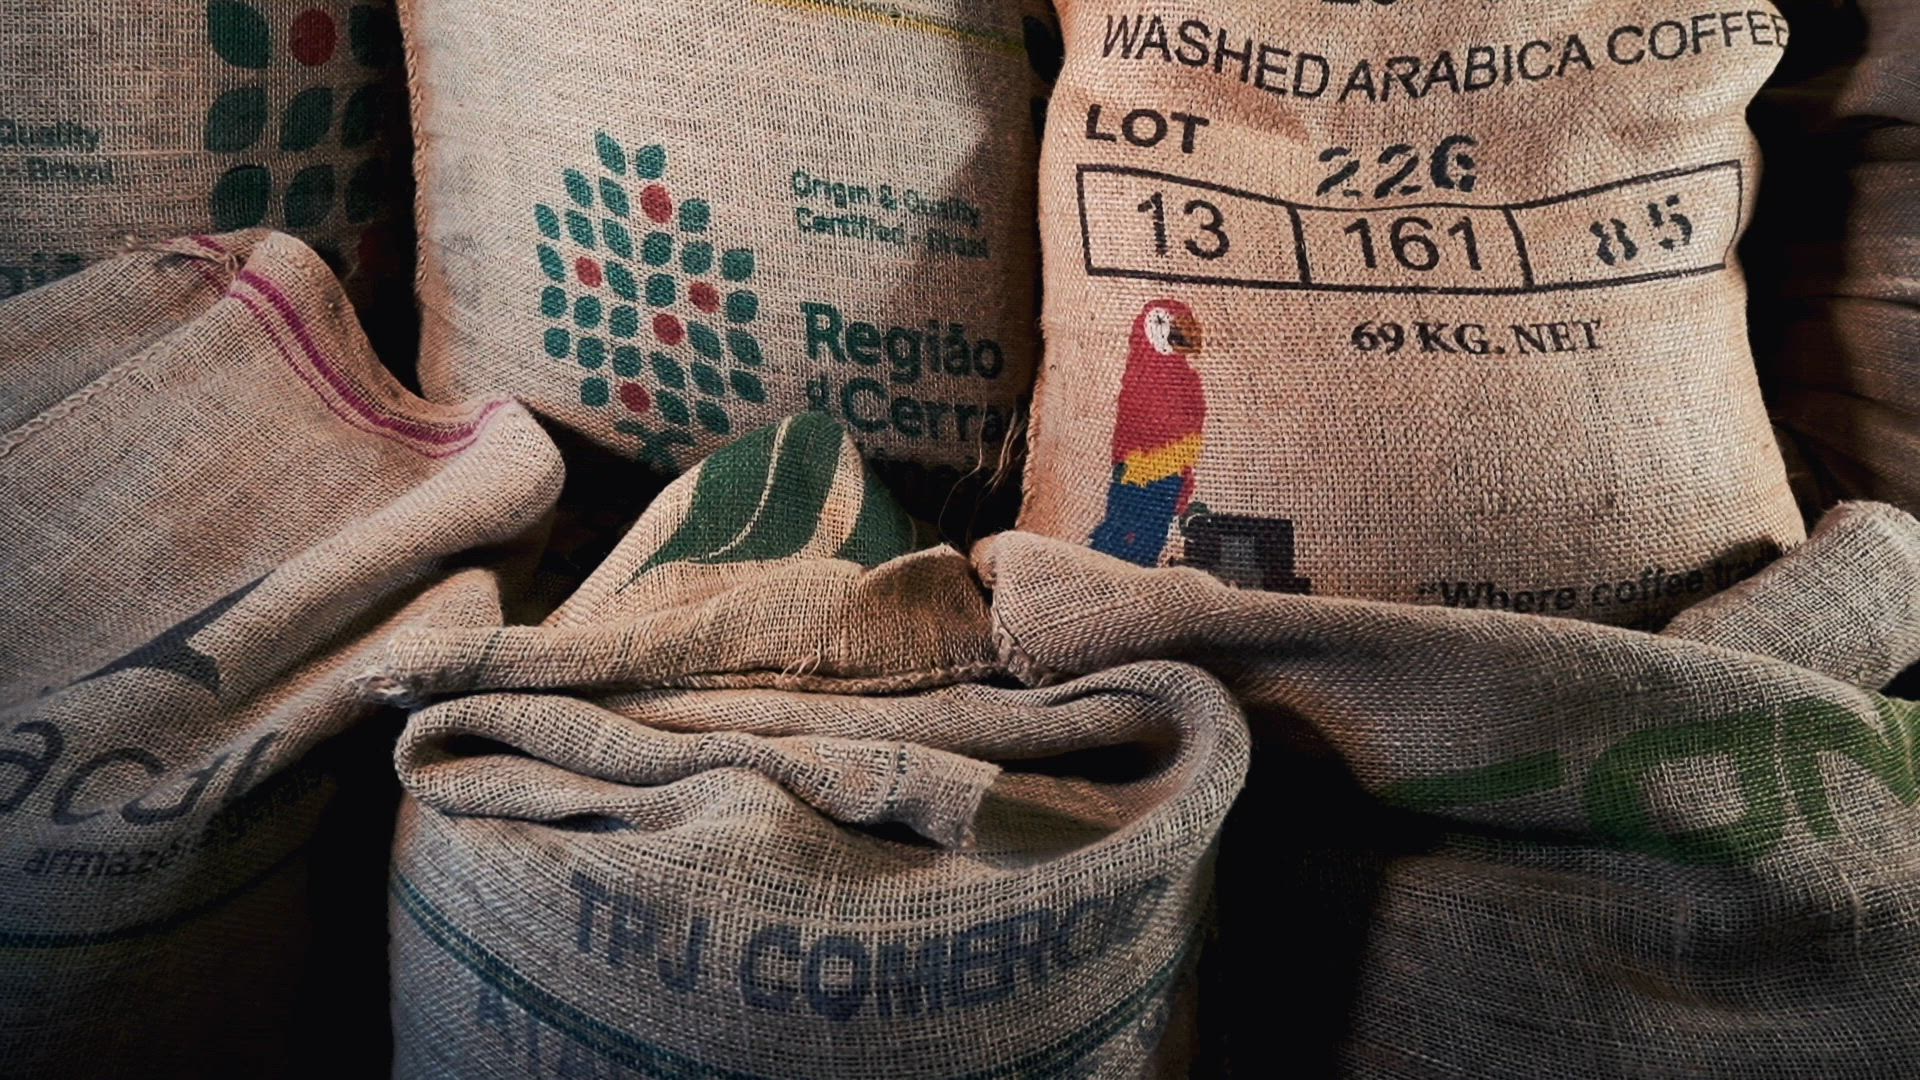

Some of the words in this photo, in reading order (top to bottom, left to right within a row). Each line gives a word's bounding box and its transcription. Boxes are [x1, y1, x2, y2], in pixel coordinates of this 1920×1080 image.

[1102, 14, 1330, 100] WASHED
[1337, 34, 1595, 103] ARABICA
[1606, 11, 1790, 66] COFFEE
[1086, 103, 1209, 154] LOT
[1315, 134, 1477, 200] 226
[1137, 191, 1230, 260] 13
[1344, 216, 1482, 272] 161
[1590, 194, 1693, 266] 85
[802, 302, 1003, 384] Região
[1351, 320, 1405, 353] 69
[1508, 319, 1602, 353] NET
[842, 376, 1007, 443] Cerra
